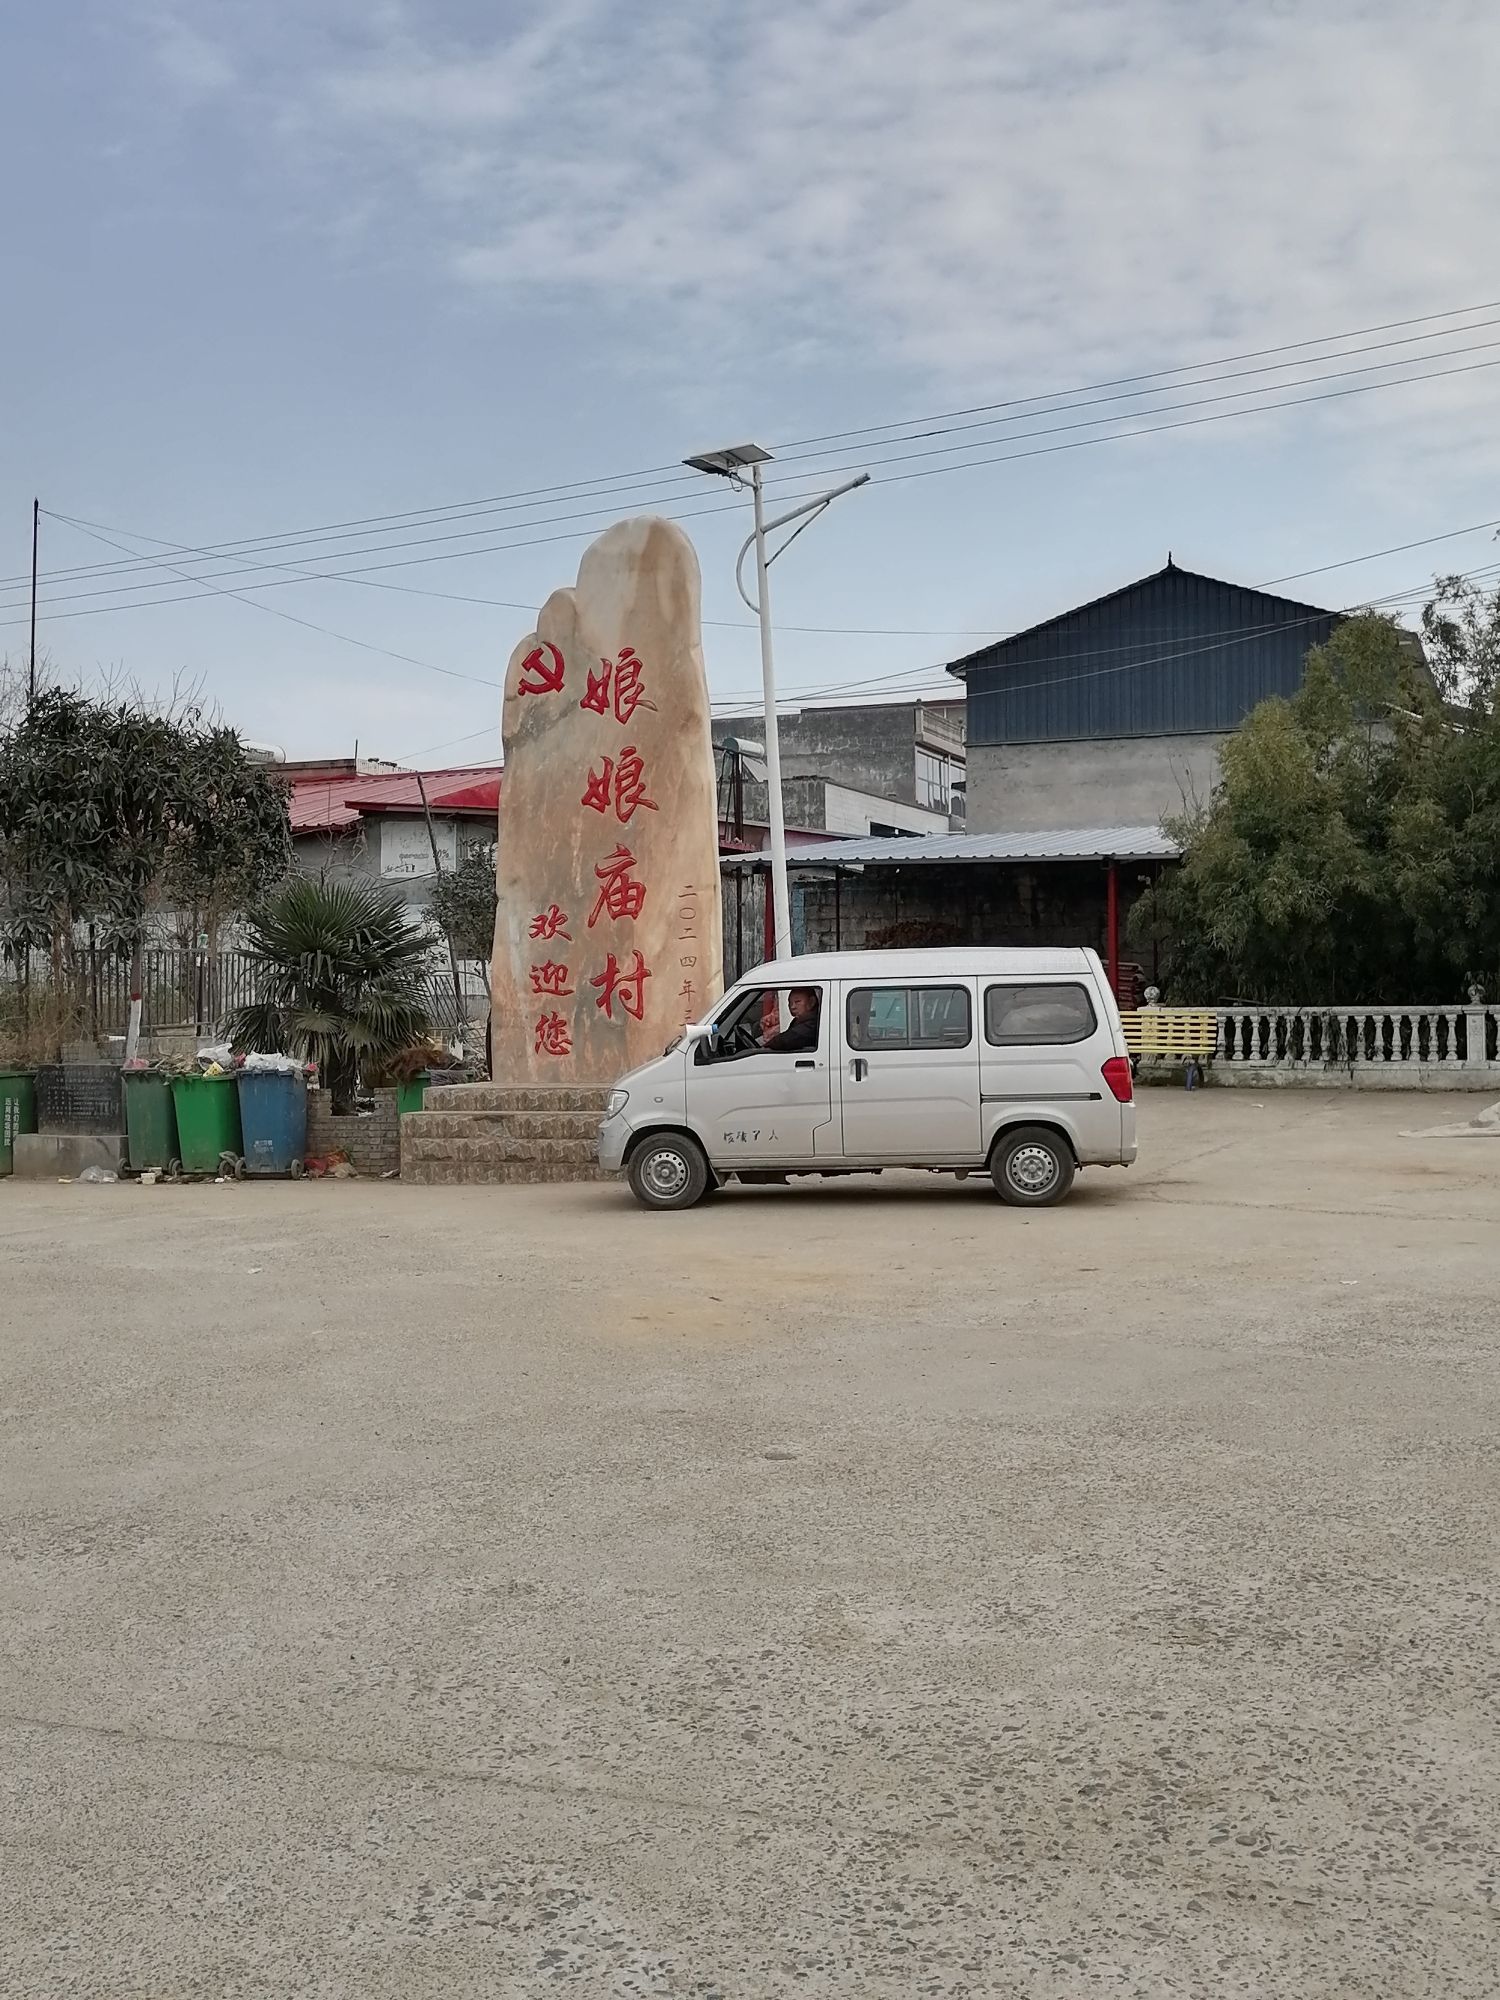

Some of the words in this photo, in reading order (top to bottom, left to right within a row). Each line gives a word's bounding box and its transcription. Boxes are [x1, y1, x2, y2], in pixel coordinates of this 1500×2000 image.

[580, 647, 659, 1020] 娘娘庙村
[528, 904, 575, 1055] 欢迎您
